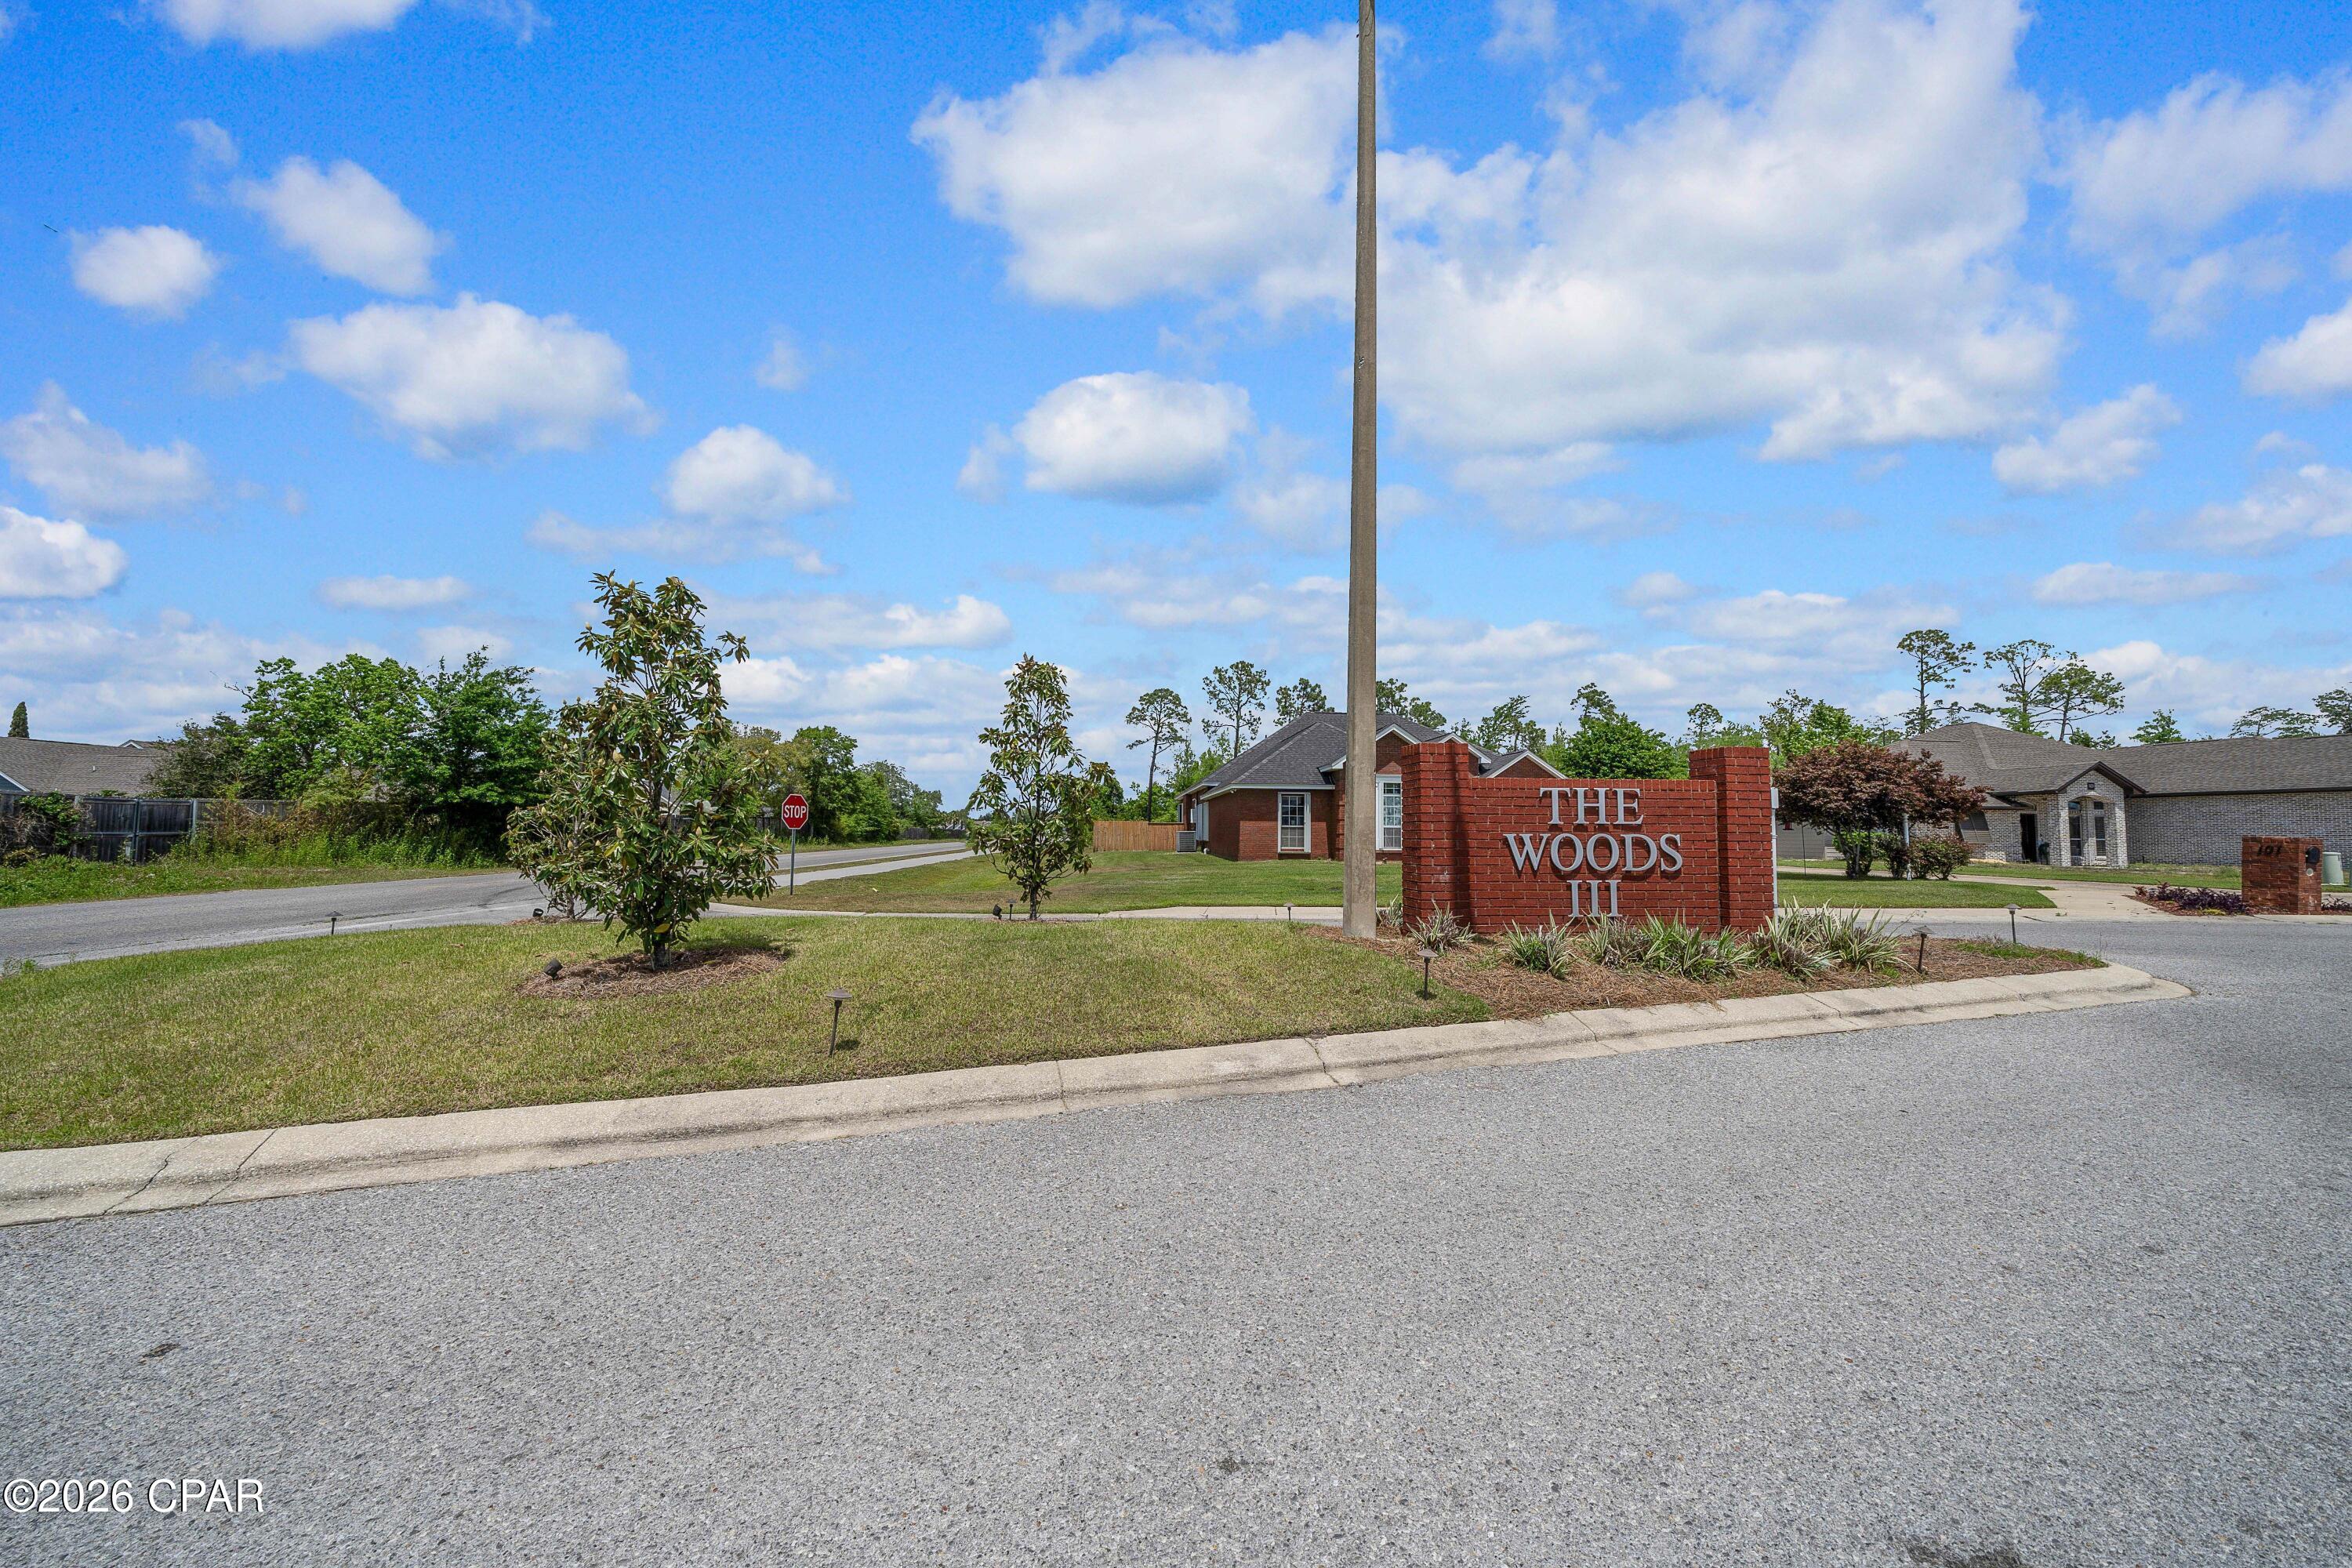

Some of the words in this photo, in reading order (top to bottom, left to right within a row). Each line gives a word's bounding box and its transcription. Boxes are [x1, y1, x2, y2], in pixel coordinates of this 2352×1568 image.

[784, 804, 807, 818] STOP
[1540, 787, 1644, 825] THE
[1503, 833, 1683, 872] WOODS
[1566, 880, 1623, 917] III
